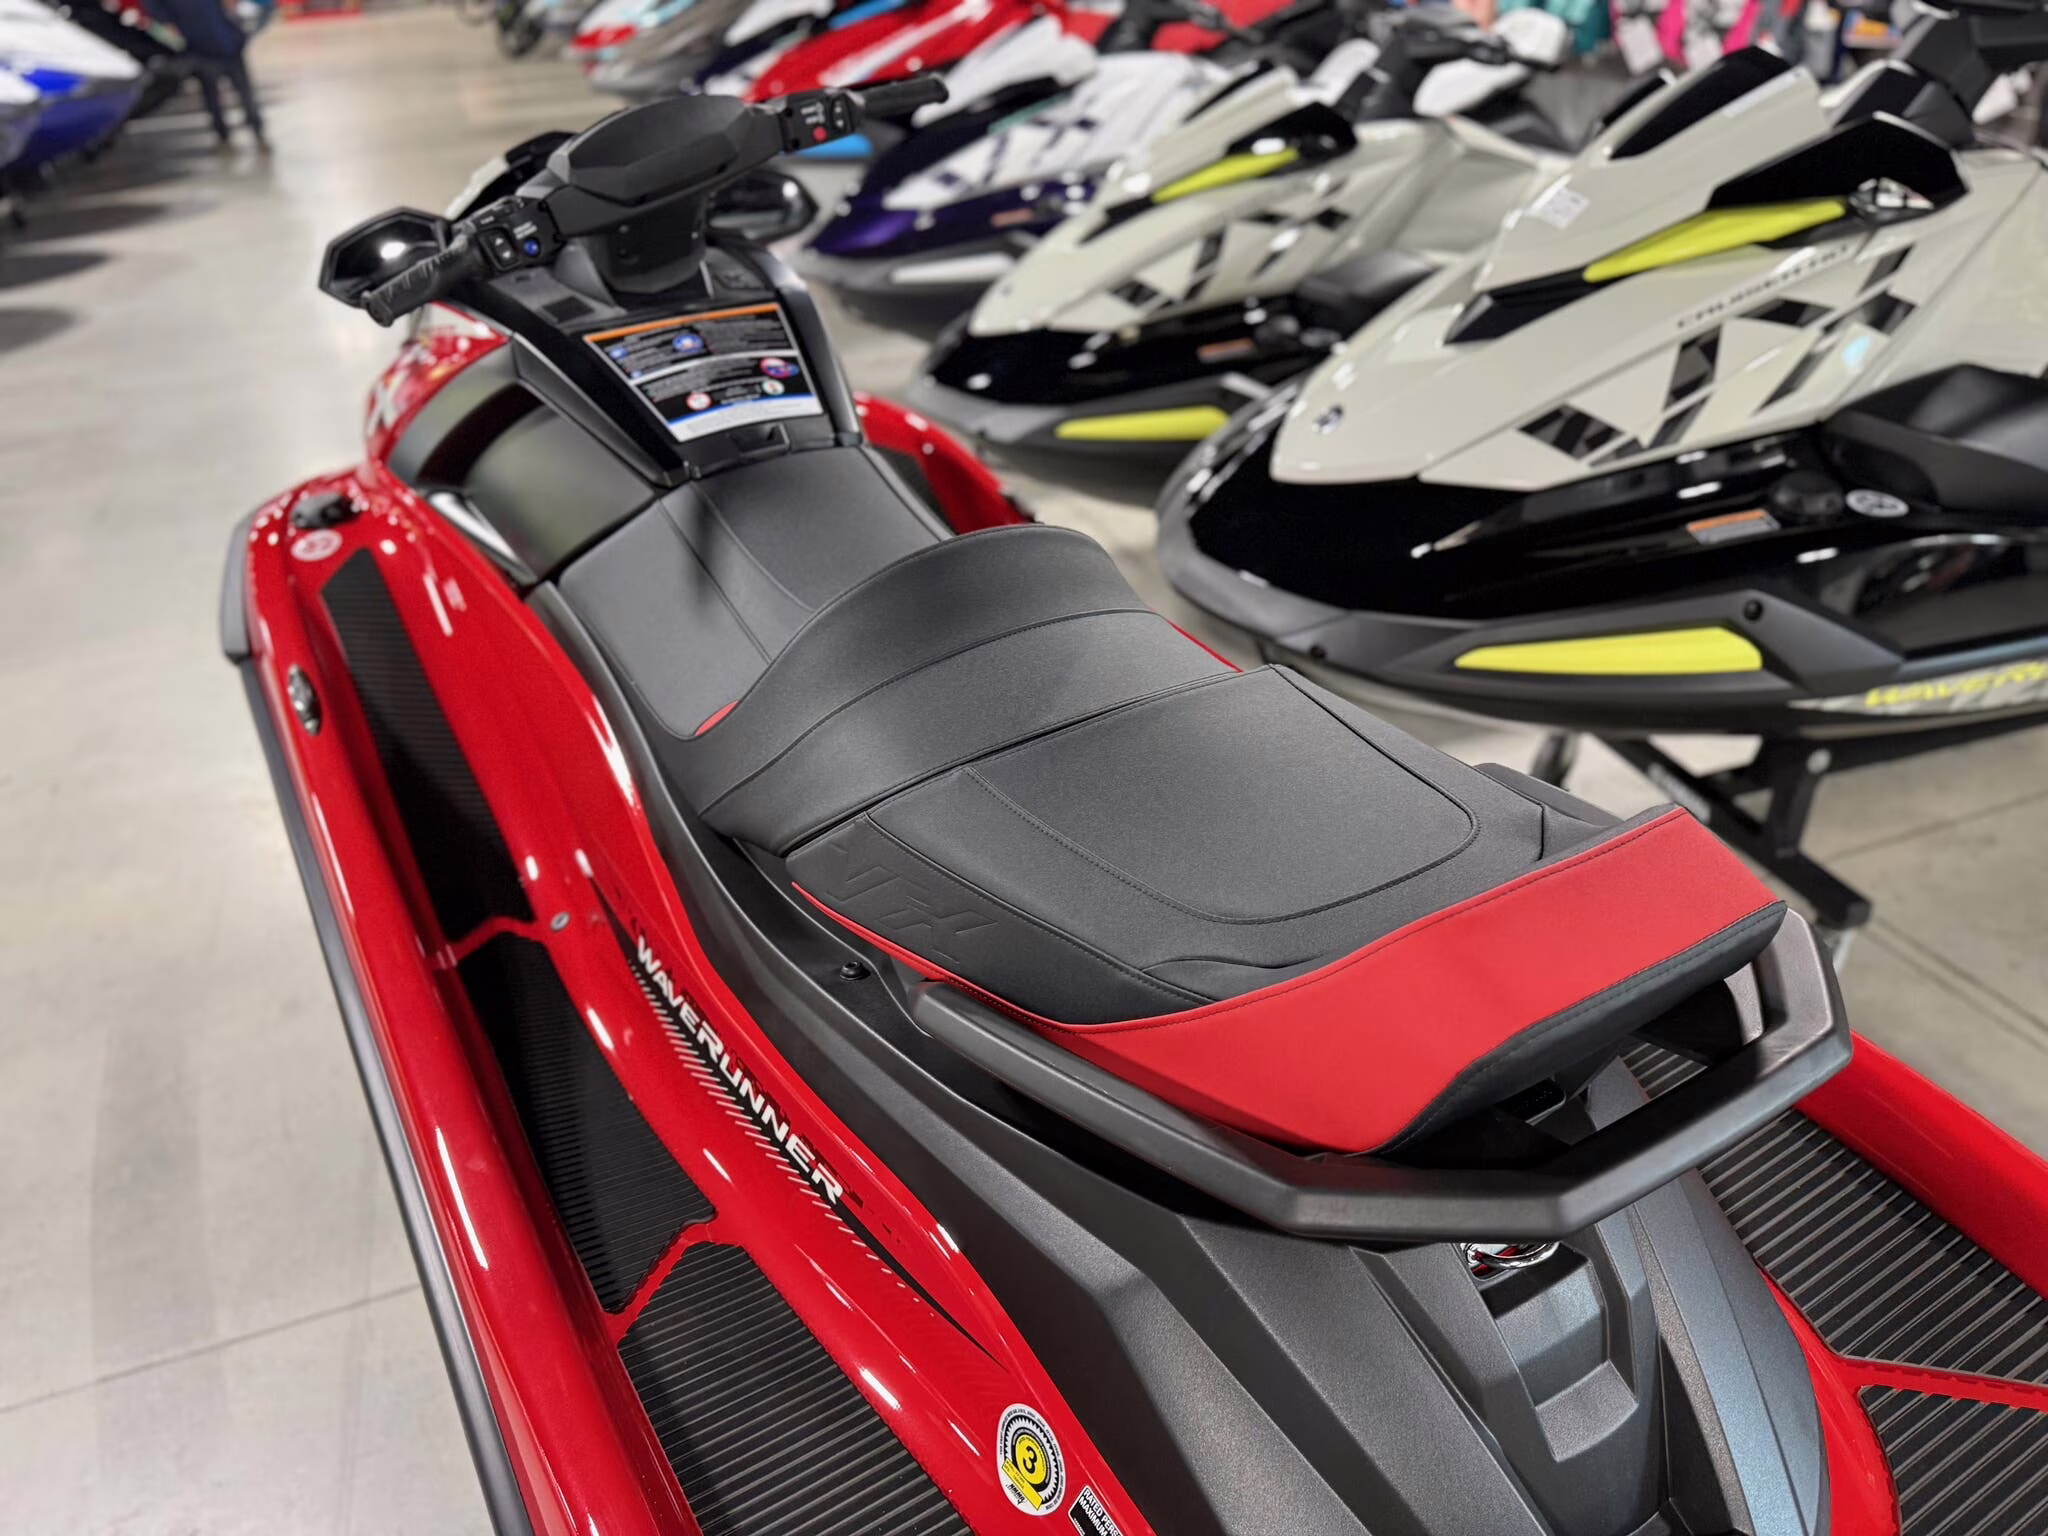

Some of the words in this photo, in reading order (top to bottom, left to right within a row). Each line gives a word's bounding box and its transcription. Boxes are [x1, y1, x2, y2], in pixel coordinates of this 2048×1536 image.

[637, 935, 846, 1206] WAVERUNNER
[1023, 1446, 1038, 1475] 3
[1078, 1496, 1108, 1536] MAXIMUM
[1083, 1489, 1104, 1517] RATED
[1101, 1515, 1121, 1536] PERS
